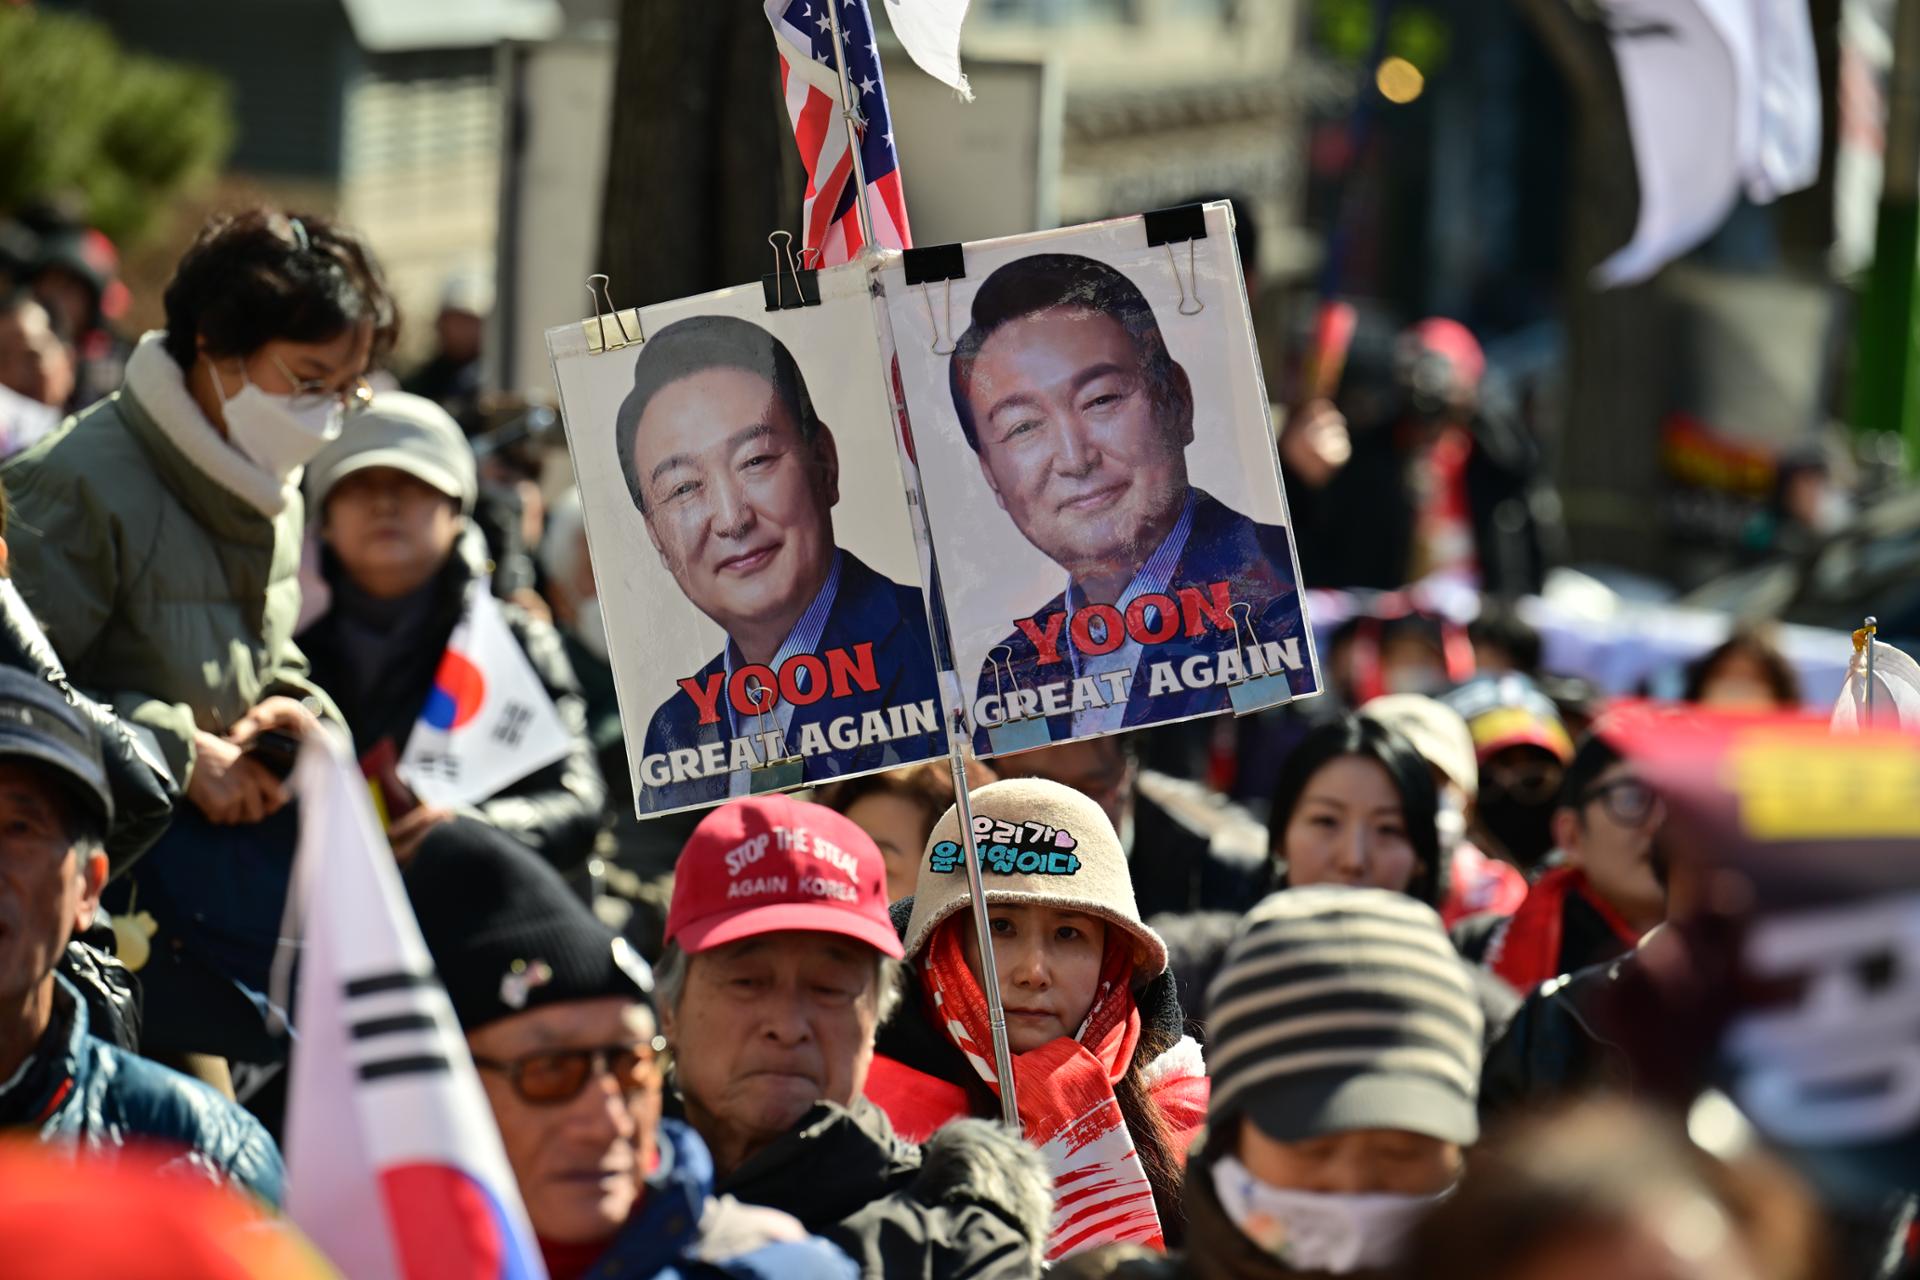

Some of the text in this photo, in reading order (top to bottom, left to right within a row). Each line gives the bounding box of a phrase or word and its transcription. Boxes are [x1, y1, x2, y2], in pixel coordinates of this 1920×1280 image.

[1013, 581, 1238, 667] YOON
[677, 642, 880, 725] YOON
[974, 637, 1303, 728] GREAT AGAIN
[640, 699, 939, 787] GREAT AGAIN
[725, 826, 860, 884] STOP THE STEAL
[972, 816, 1055, 844] 우리가
[727, 875, 859, 903] AGAIN KOREA
